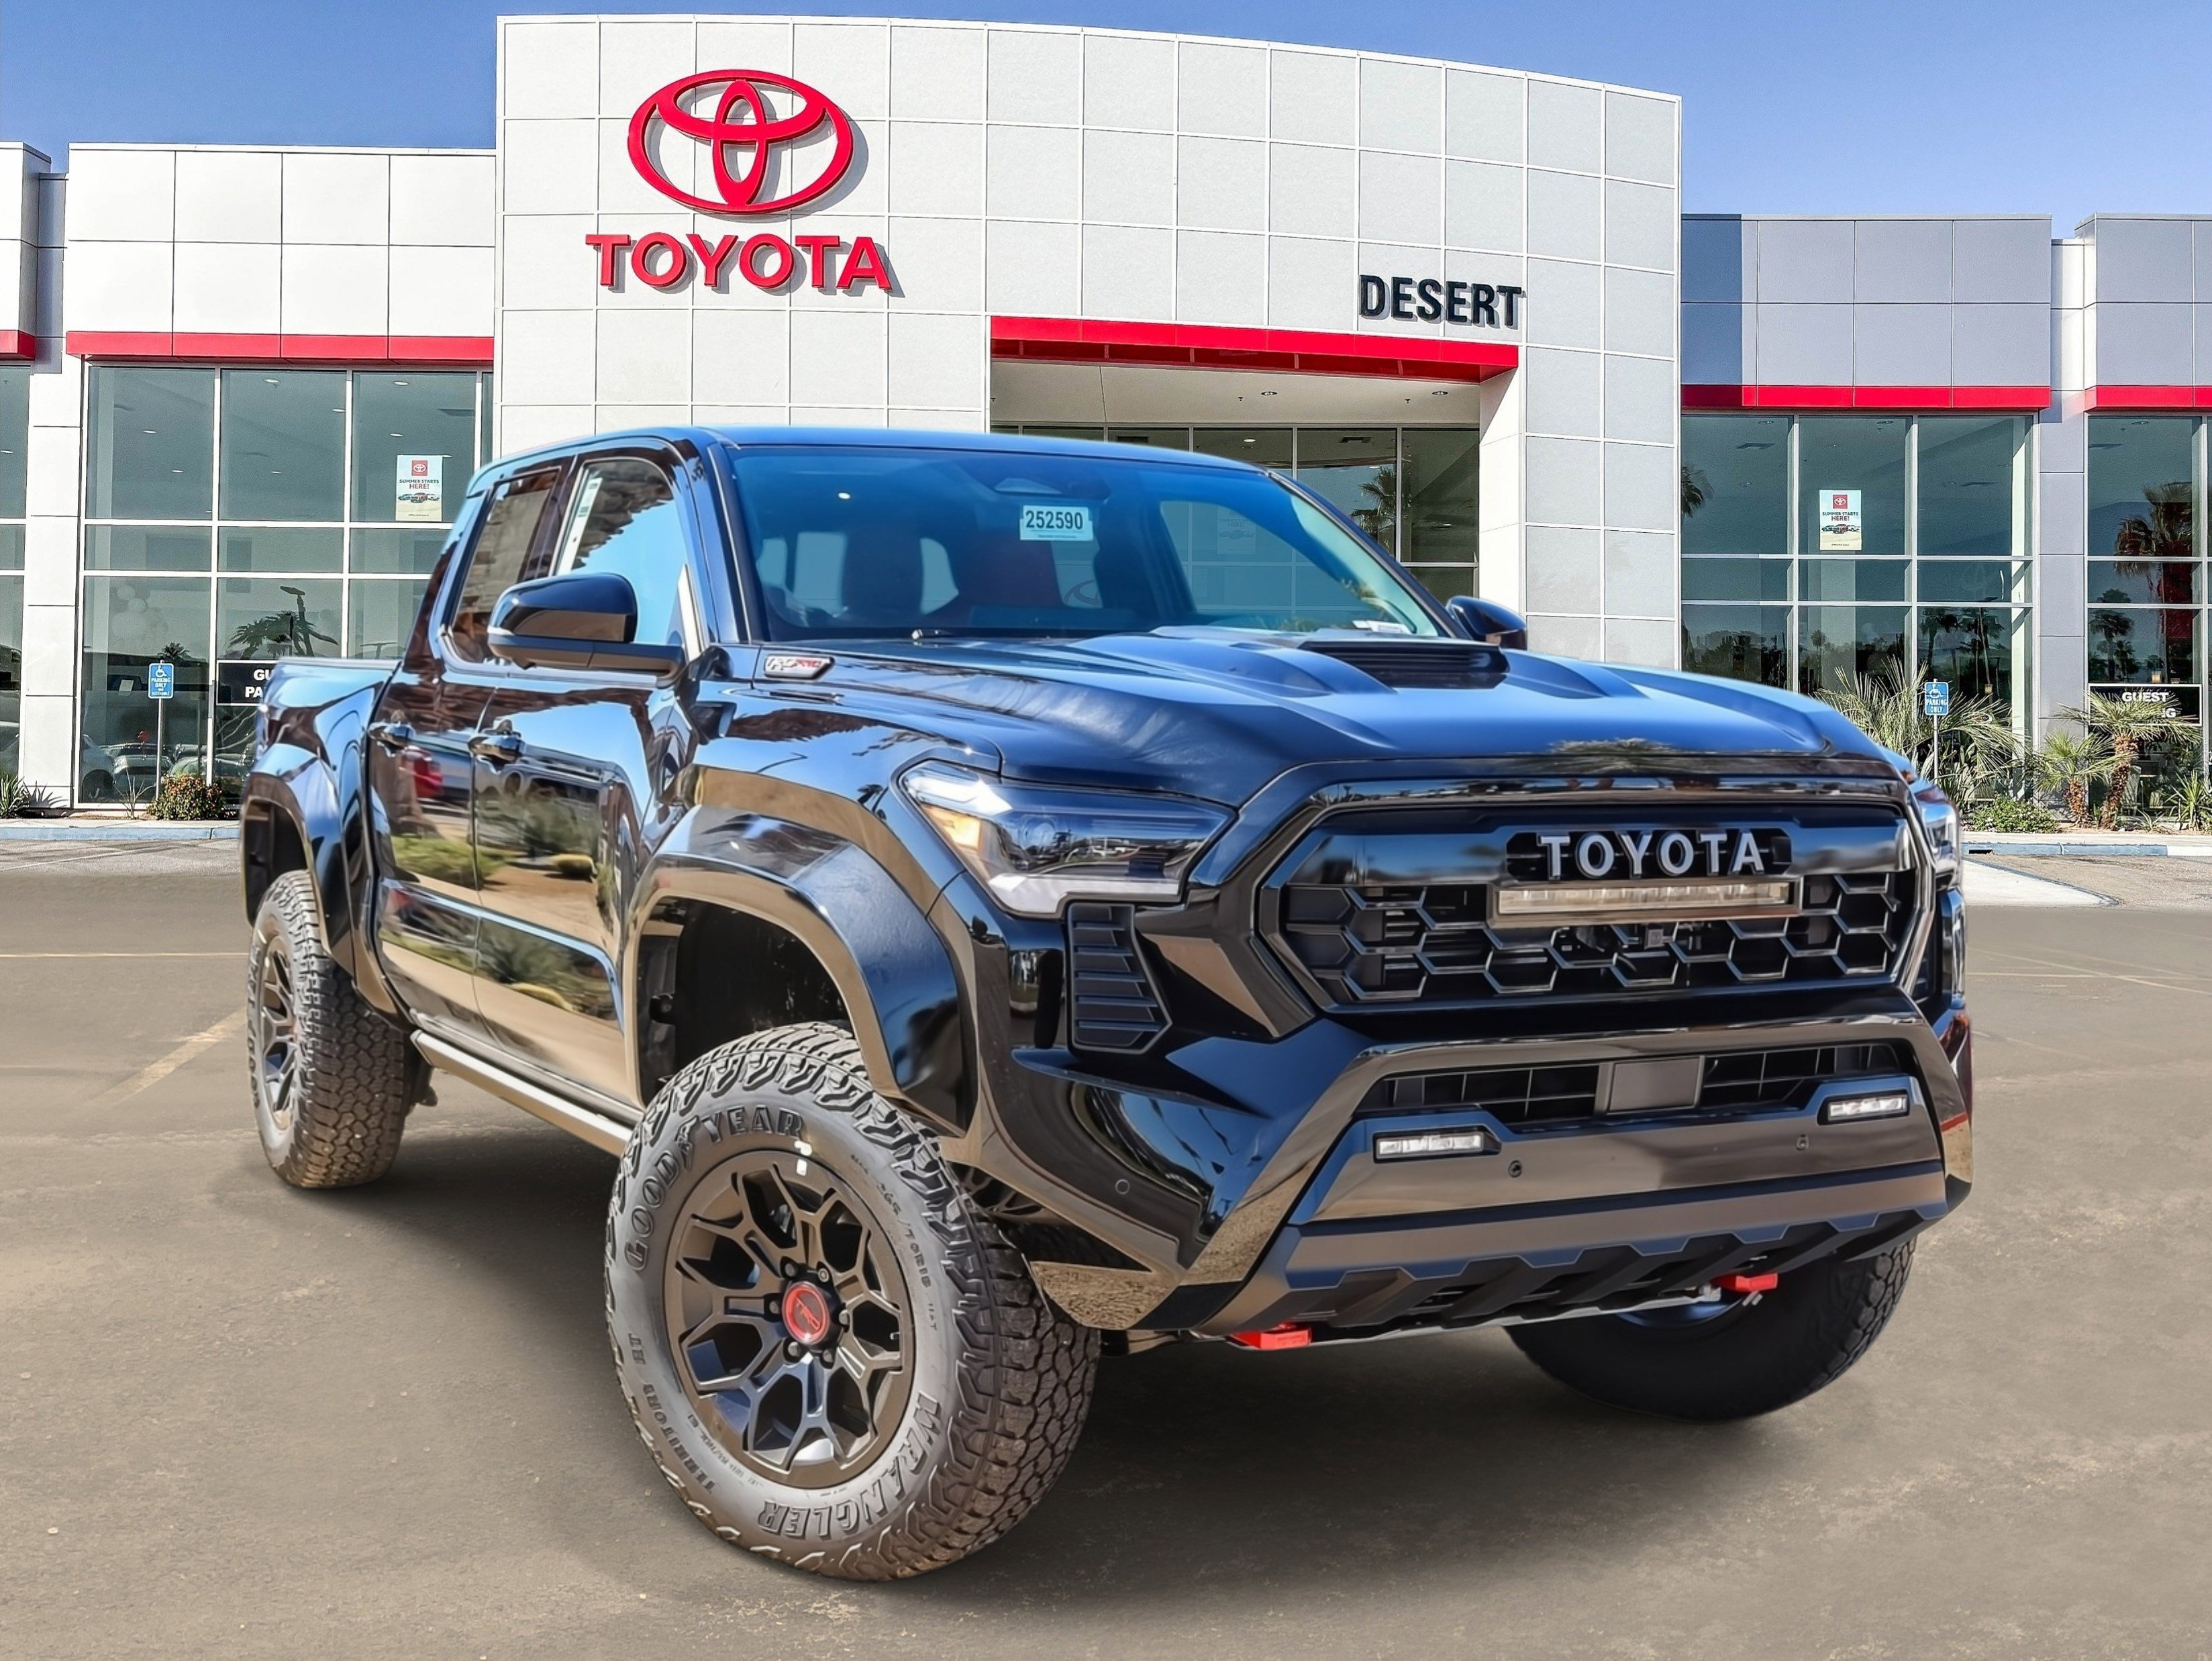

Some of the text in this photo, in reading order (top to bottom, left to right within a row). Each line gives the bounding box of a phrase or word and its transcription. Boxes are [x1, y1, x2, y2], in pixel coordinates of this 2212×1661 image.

[585, 232, 893, 291] TOYOTA
[1359, 274, 1523, 327] DESERT
[1025, 510, 1084, 530] 252590
[2121, 691, 2169, 703] GUEST
[1538, 829, 1765, 878] TOYOTA
[757, 1390, 942, 1540] WRANGLER
